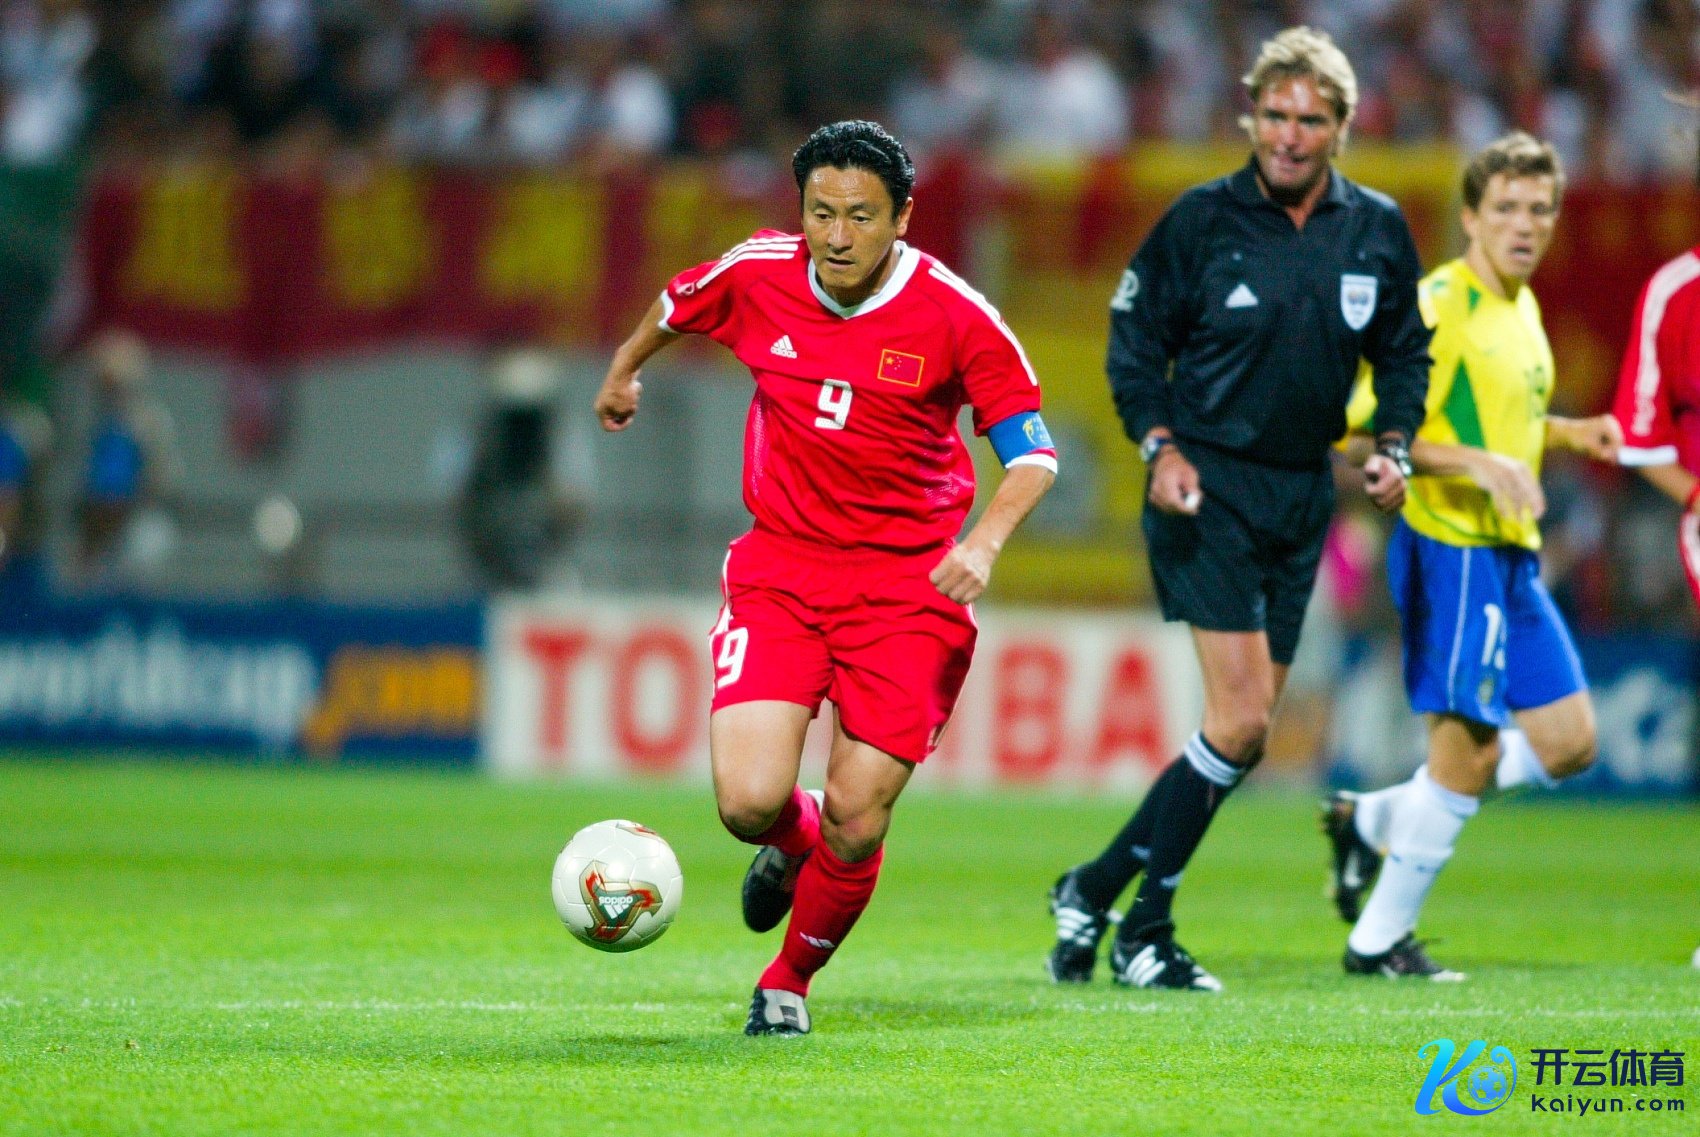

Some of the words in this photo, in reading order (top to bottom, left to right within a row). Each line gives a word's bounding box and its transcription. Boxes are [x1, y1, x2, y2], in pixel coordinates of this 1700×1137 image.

[814, 378, 853, 430] 9
[717, 627, 749, 689] 9
[520, 625, 1168, 775] TOBA
